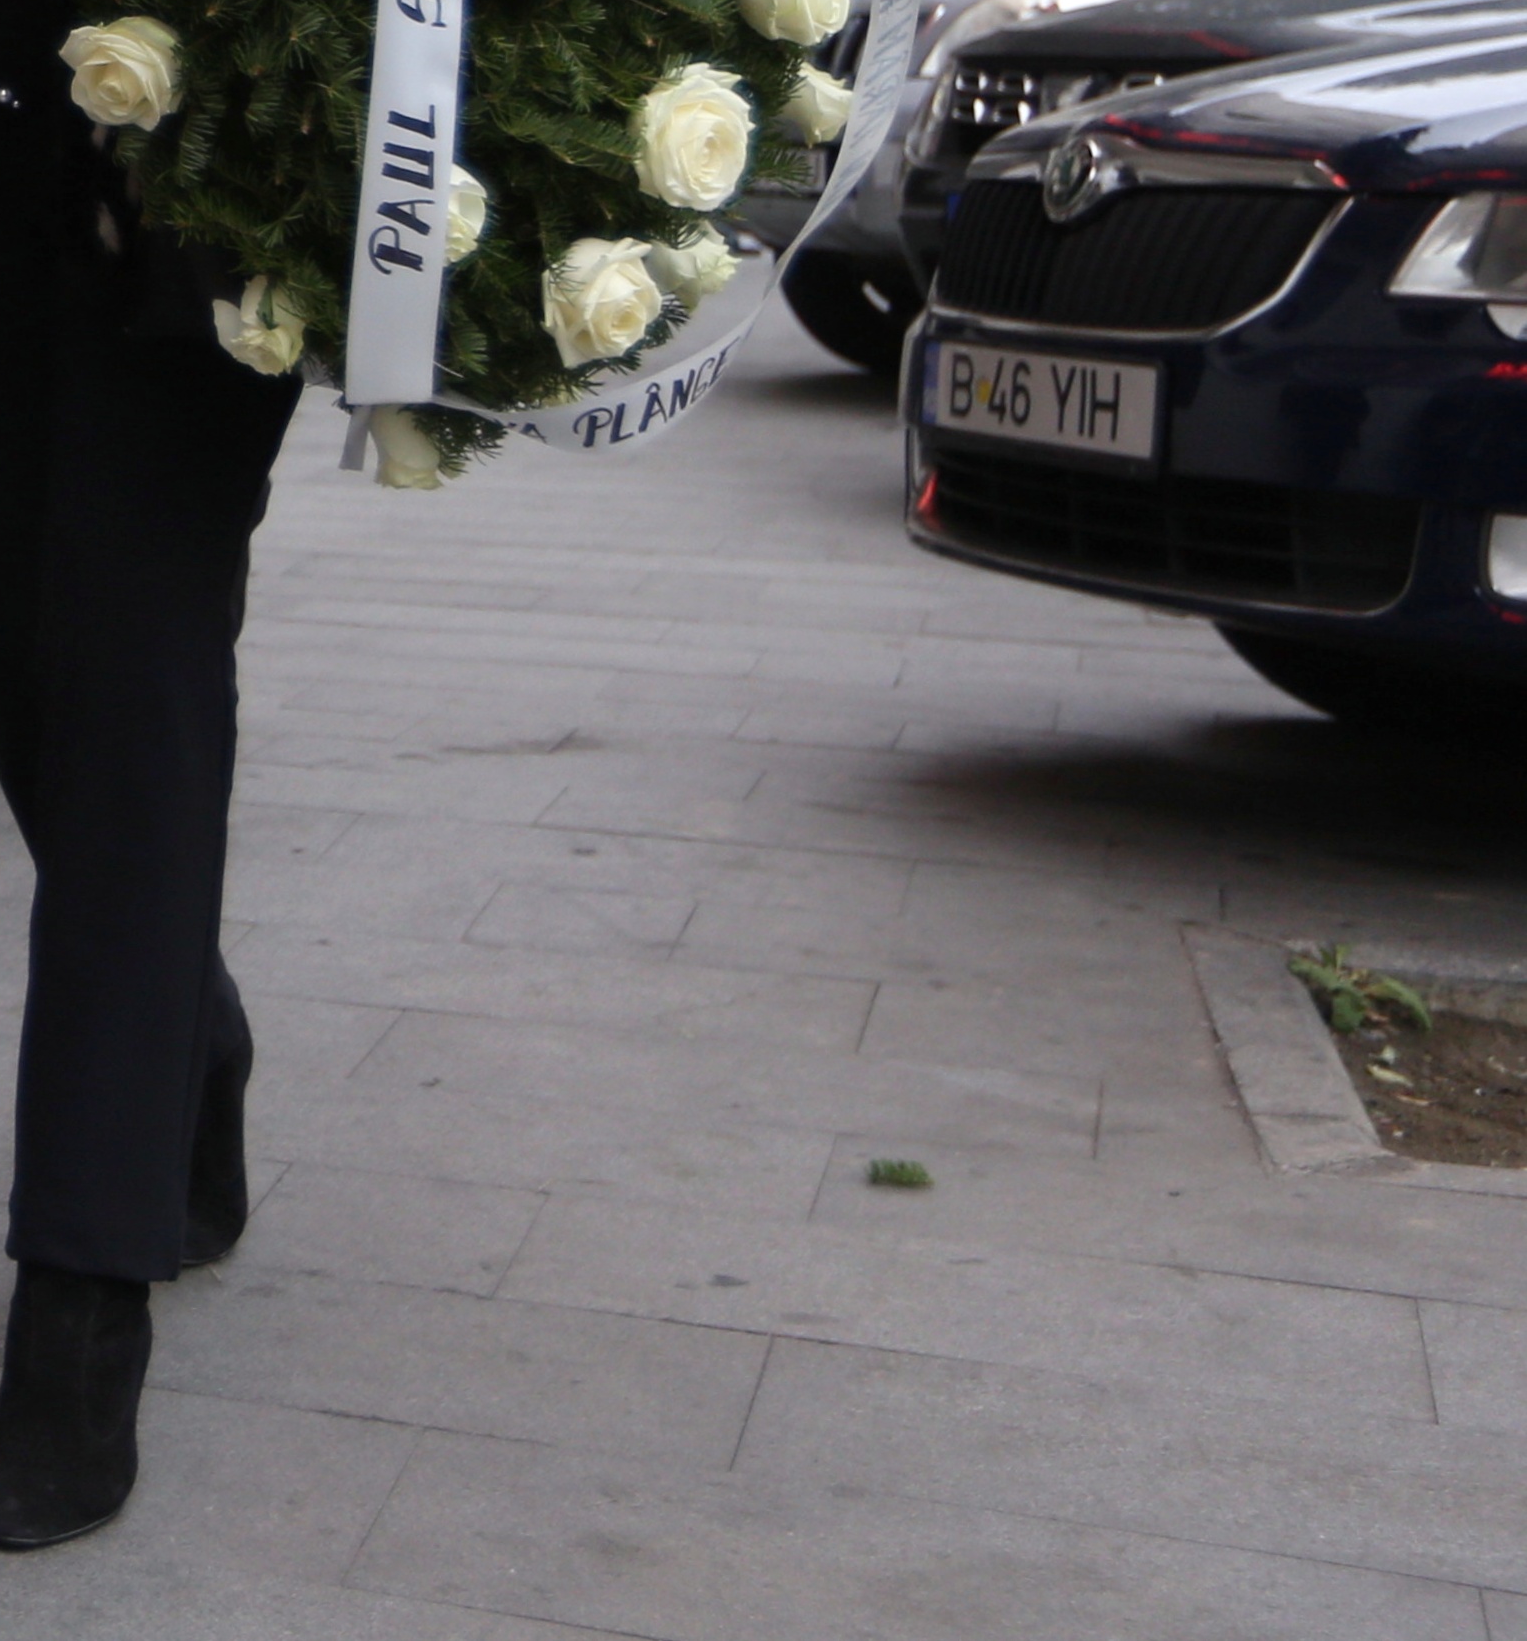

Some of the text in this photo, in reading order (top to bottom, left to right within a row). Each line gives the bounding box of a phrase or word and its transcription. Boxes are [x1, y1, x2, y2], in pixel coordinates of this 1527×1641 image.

[368, 104, 436, 275] PAUL
[950, 352, 1121, 442] B 46 YIH
